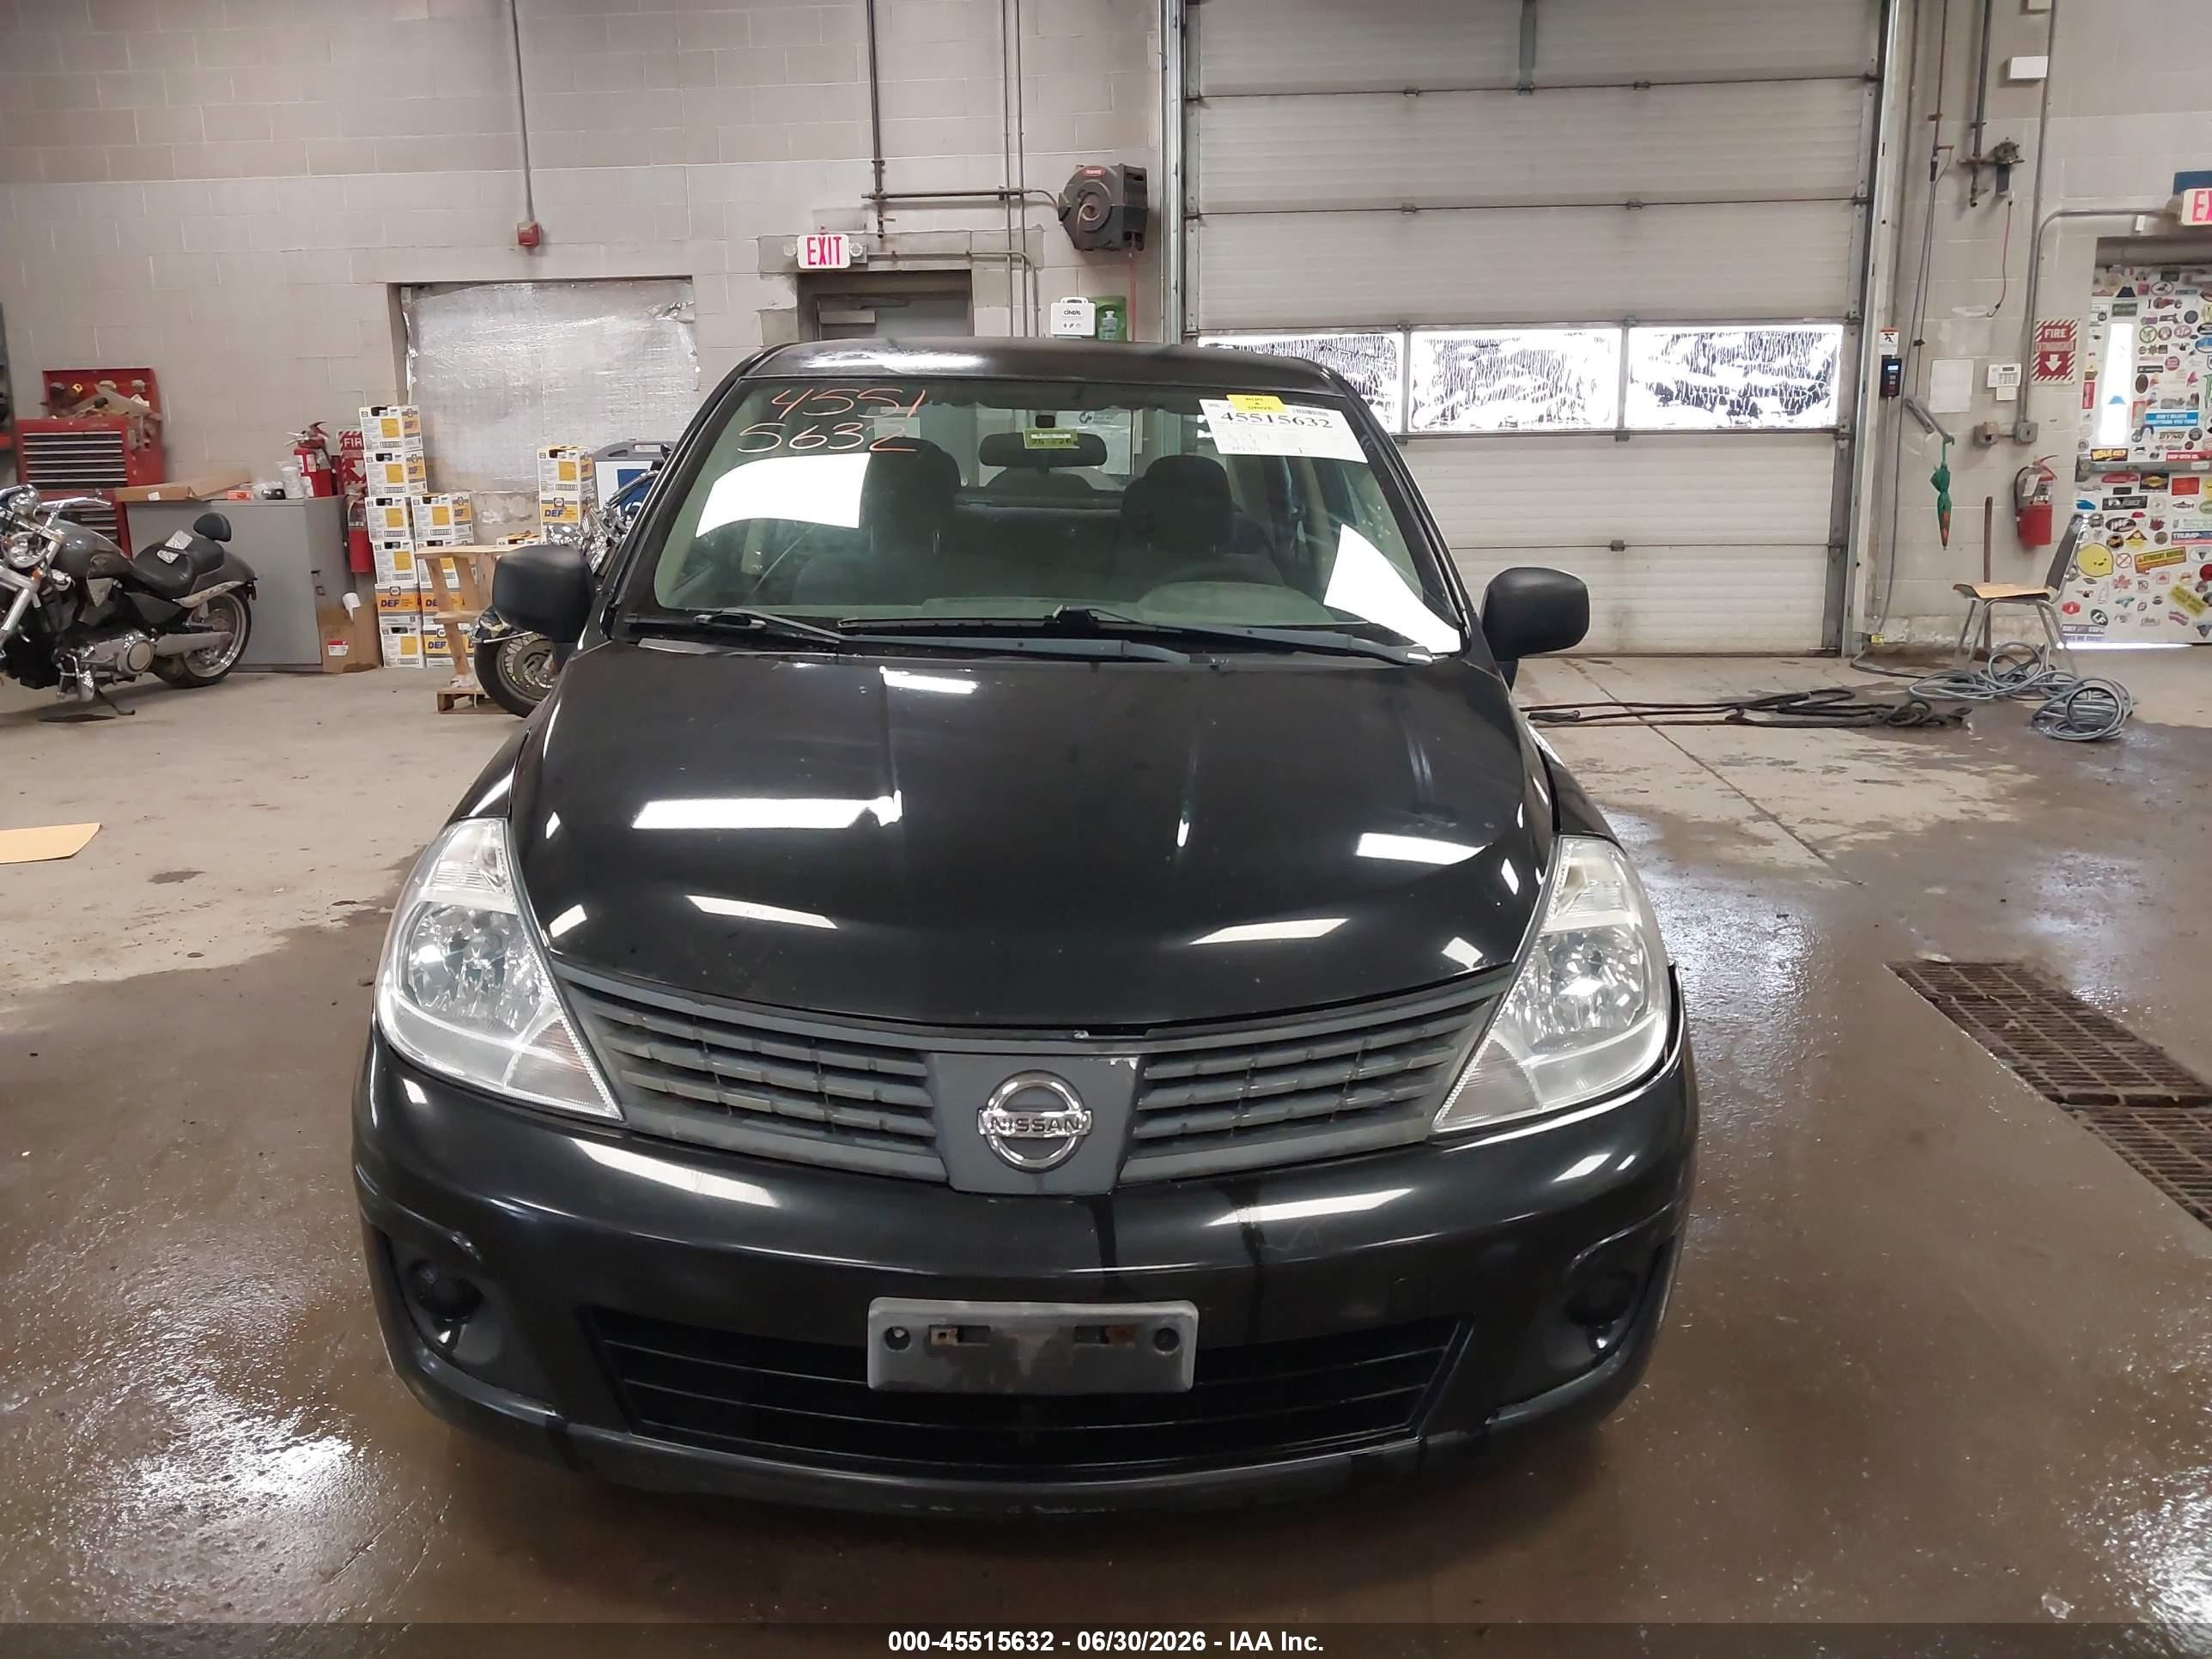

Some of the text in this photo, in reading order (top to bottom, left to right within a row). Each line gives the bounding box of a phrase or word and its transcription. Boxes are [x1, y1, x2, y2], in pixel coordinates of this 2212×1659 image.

[806, 236, 842, 265] EXIT
[2045, 328, 2068, 338] FIRE
[771, 388, 927, 419] 4551
[1220, 411, 1334, 428] 45515632
[737, 422, 919, 453] 5632
[380, 599, 399, 607] DEF
[428, 641, 447, 649] DEF
[990, 1117, 1079, 1133] NISSAN
